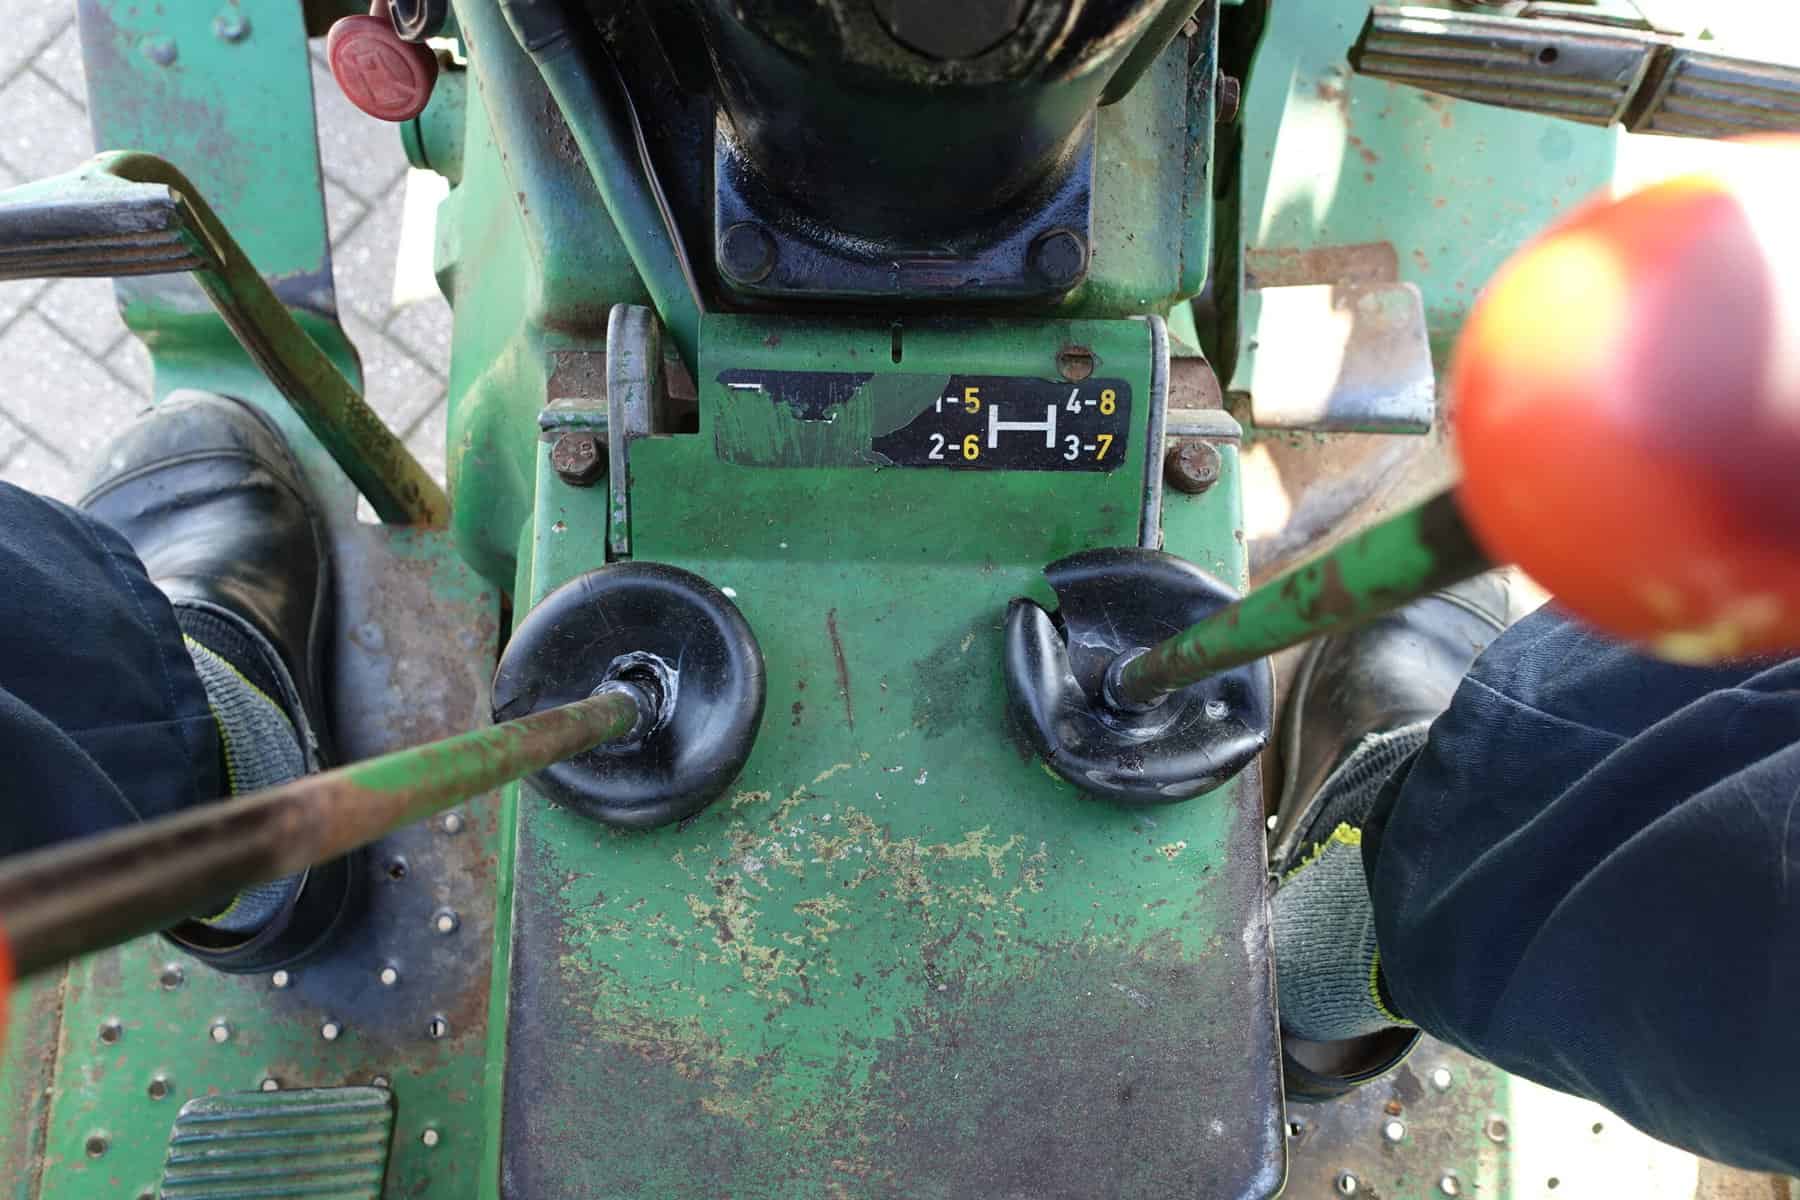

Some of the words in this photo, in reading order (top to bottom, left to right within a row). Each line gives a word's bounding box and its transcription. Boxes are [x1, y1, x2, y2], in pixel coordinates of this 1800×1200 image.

[1066, 388, 1116, 415] 4-8
[928, 433, 980, 460] 2-6
[1063, 434, 1113, 460] 3-7
